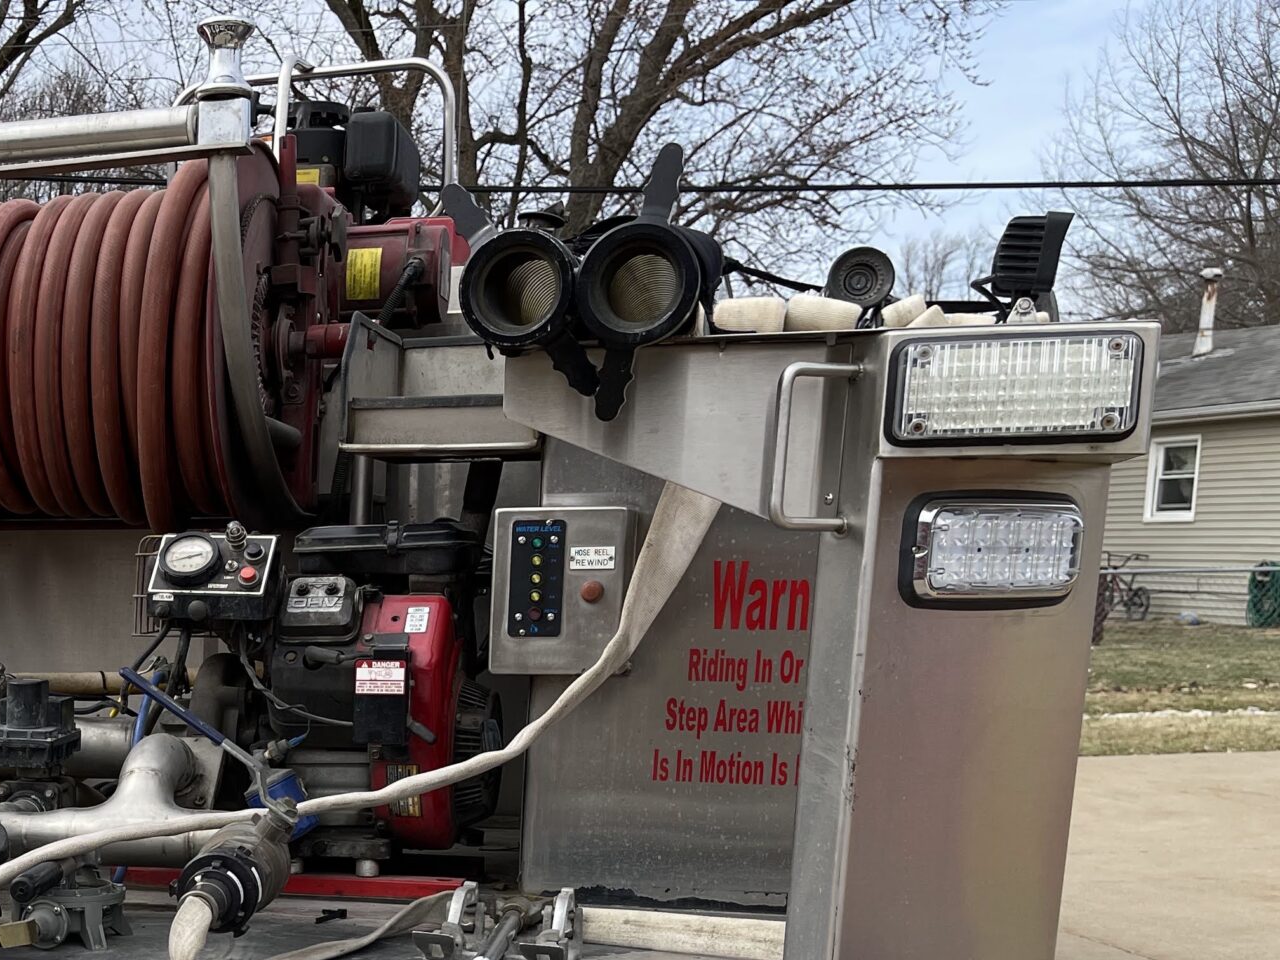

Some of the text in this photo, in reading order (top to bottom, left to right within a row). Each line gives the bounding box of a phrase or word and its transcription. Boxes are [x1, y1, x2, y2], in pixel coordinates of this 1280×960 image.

[516, 525, 562, 533] WATER LEVEL
[292, 597, 340, 608] OHV
[713, 560, 810, 631] Warn
[688, 648, 804, 691] Riding In Or
[665, 697, 707, 739] Step
[713, 699, 759, 733] Area
[652, 748, 669, 782] Is
[675, 749, 693, 782] In
[699, 750, 765, 784] Motion
[770, 752, 788, 785] Is
